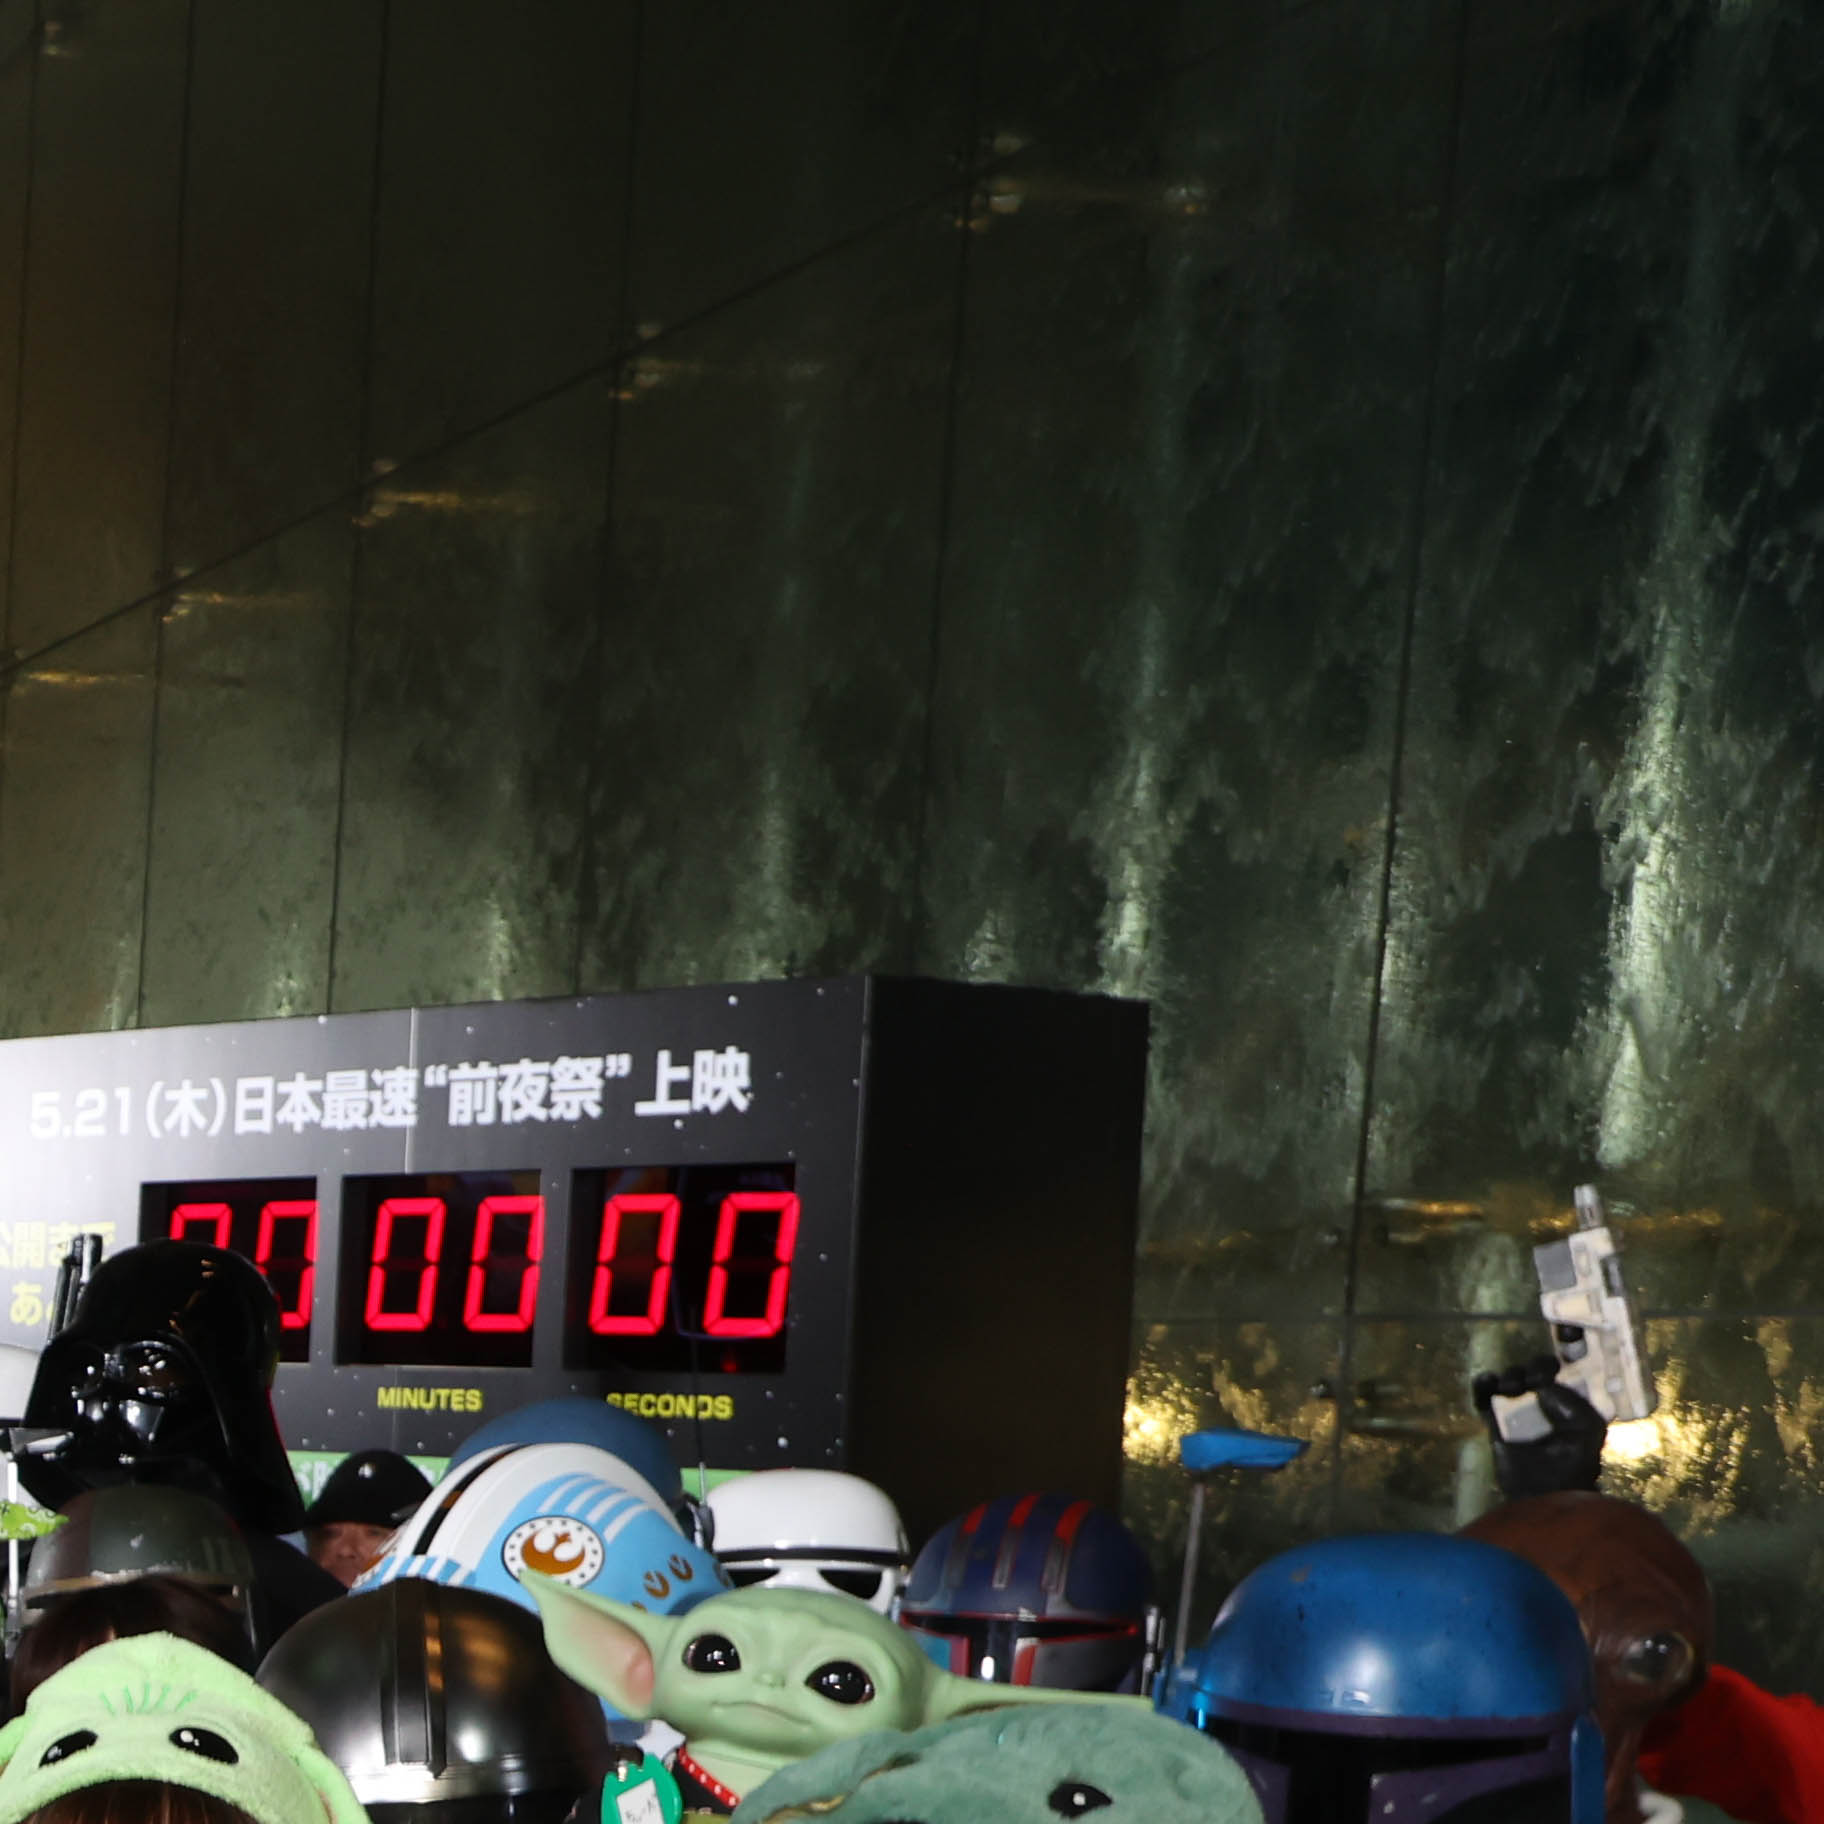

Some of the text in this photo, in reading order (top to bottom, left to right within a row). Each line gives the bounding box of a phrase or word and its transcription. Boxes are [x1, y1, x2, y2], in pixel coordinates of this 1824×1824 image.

[169, 1192, 800, 1336] 0 00 00
[377, 1386, 483, 1413] MINUTES
